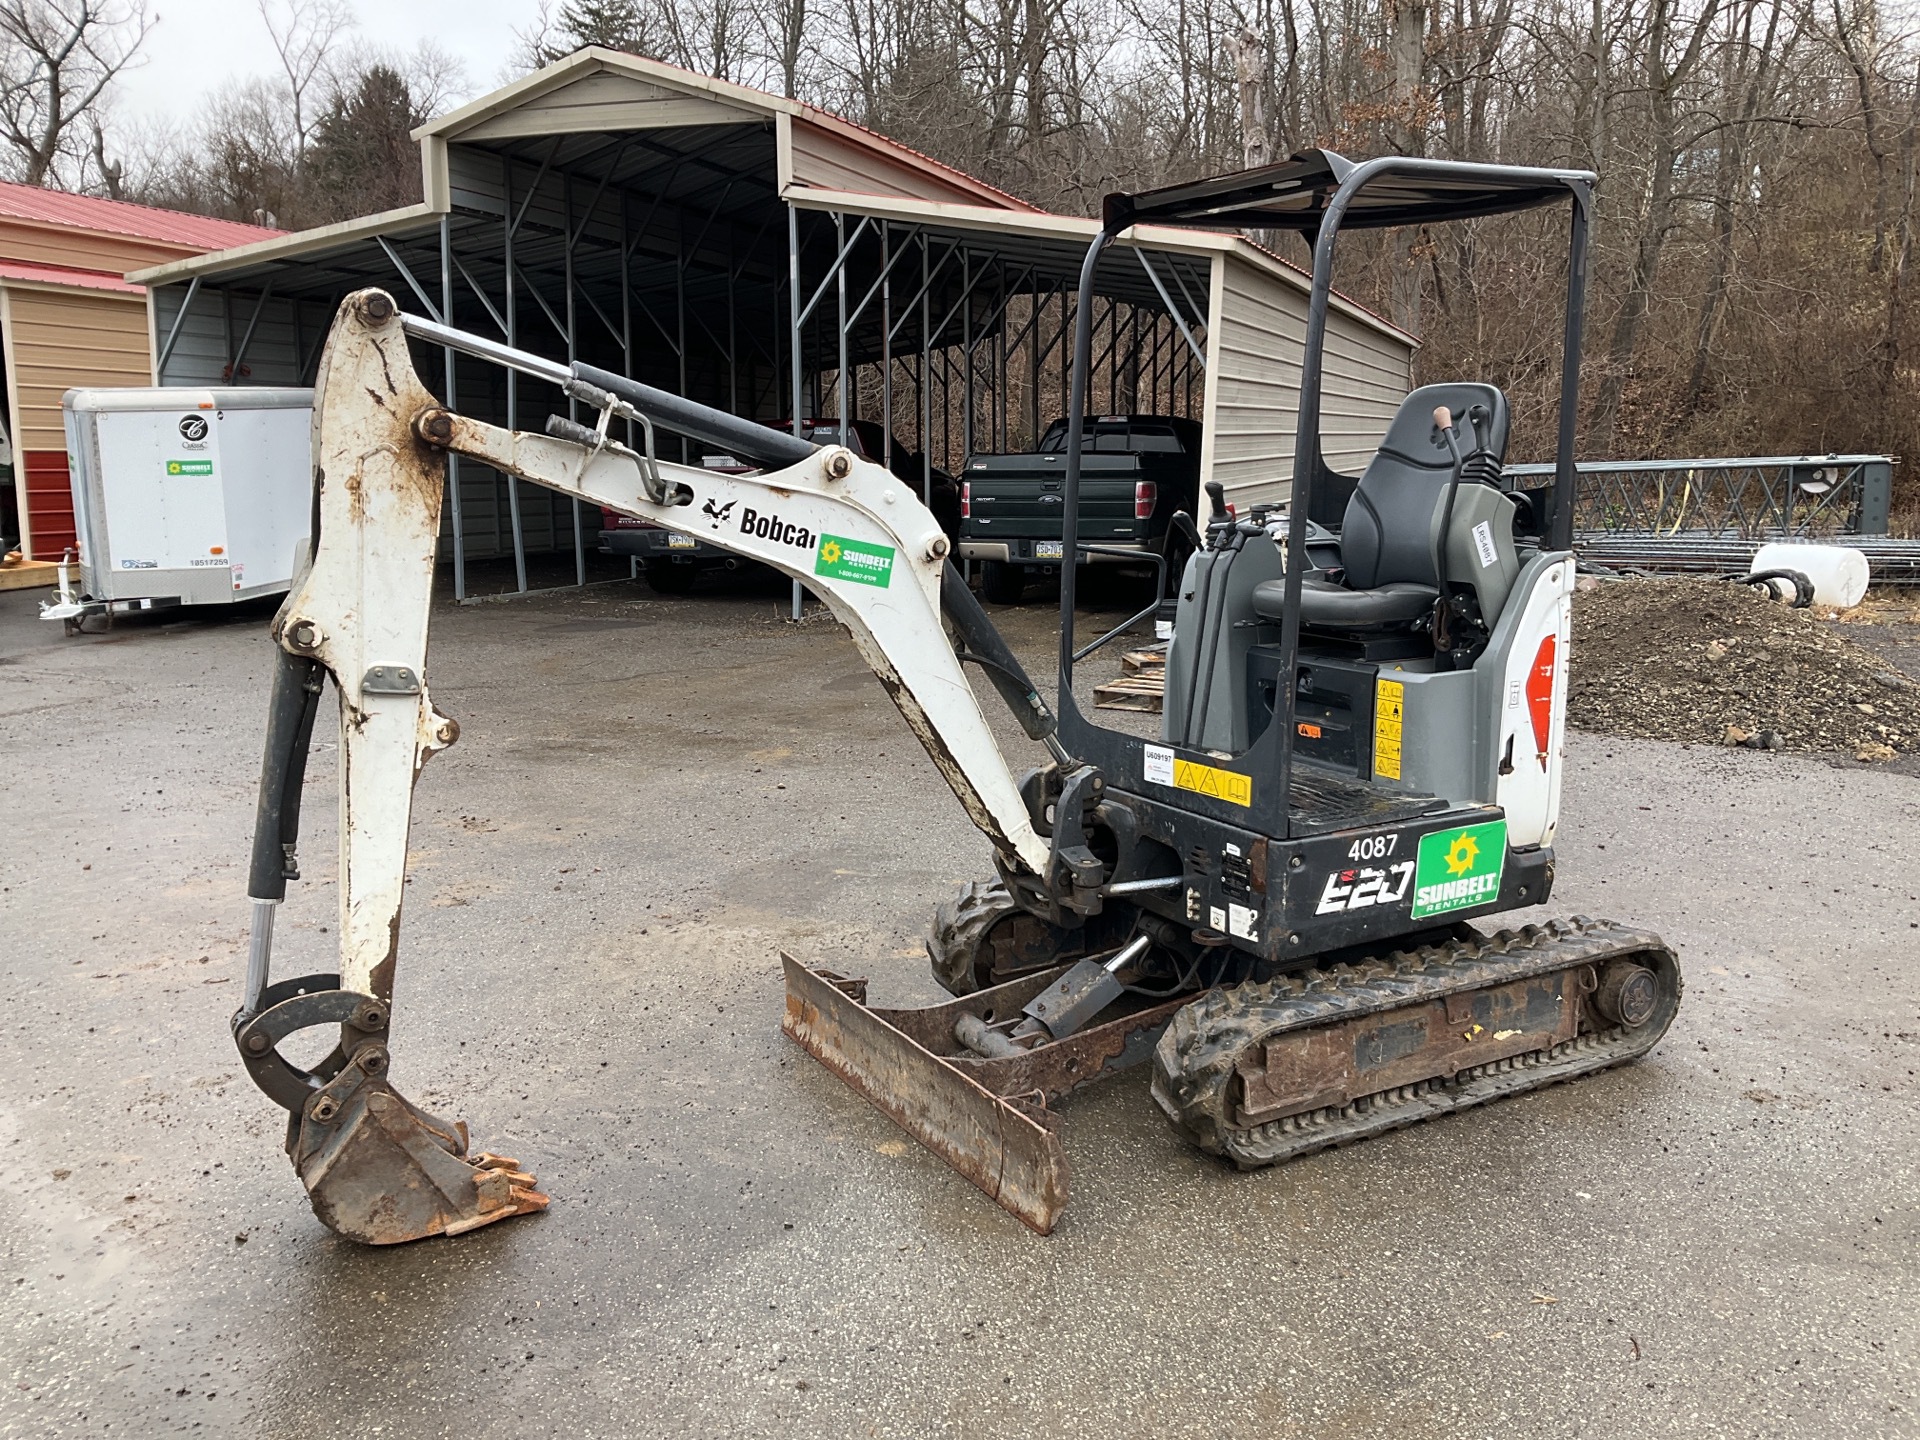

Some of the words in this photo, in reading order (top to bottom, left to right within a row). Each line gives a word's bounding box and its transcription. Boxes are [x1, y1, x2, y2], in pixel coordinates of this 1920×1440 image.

[1476, 524, 1493, 563] LRS4087
[190, 559, 229, 567] 10517259
[843, 550, 891, 569] SUNBELT
[848, 561, 883, 572] RENTALS
[1146, 751, 1172, 763] U609197
[1348, 834, 1398, 862] 4087
[1416, 872, 1497, 907] SUNBELT
[1426, 893, 1483, 912] RENTALS
